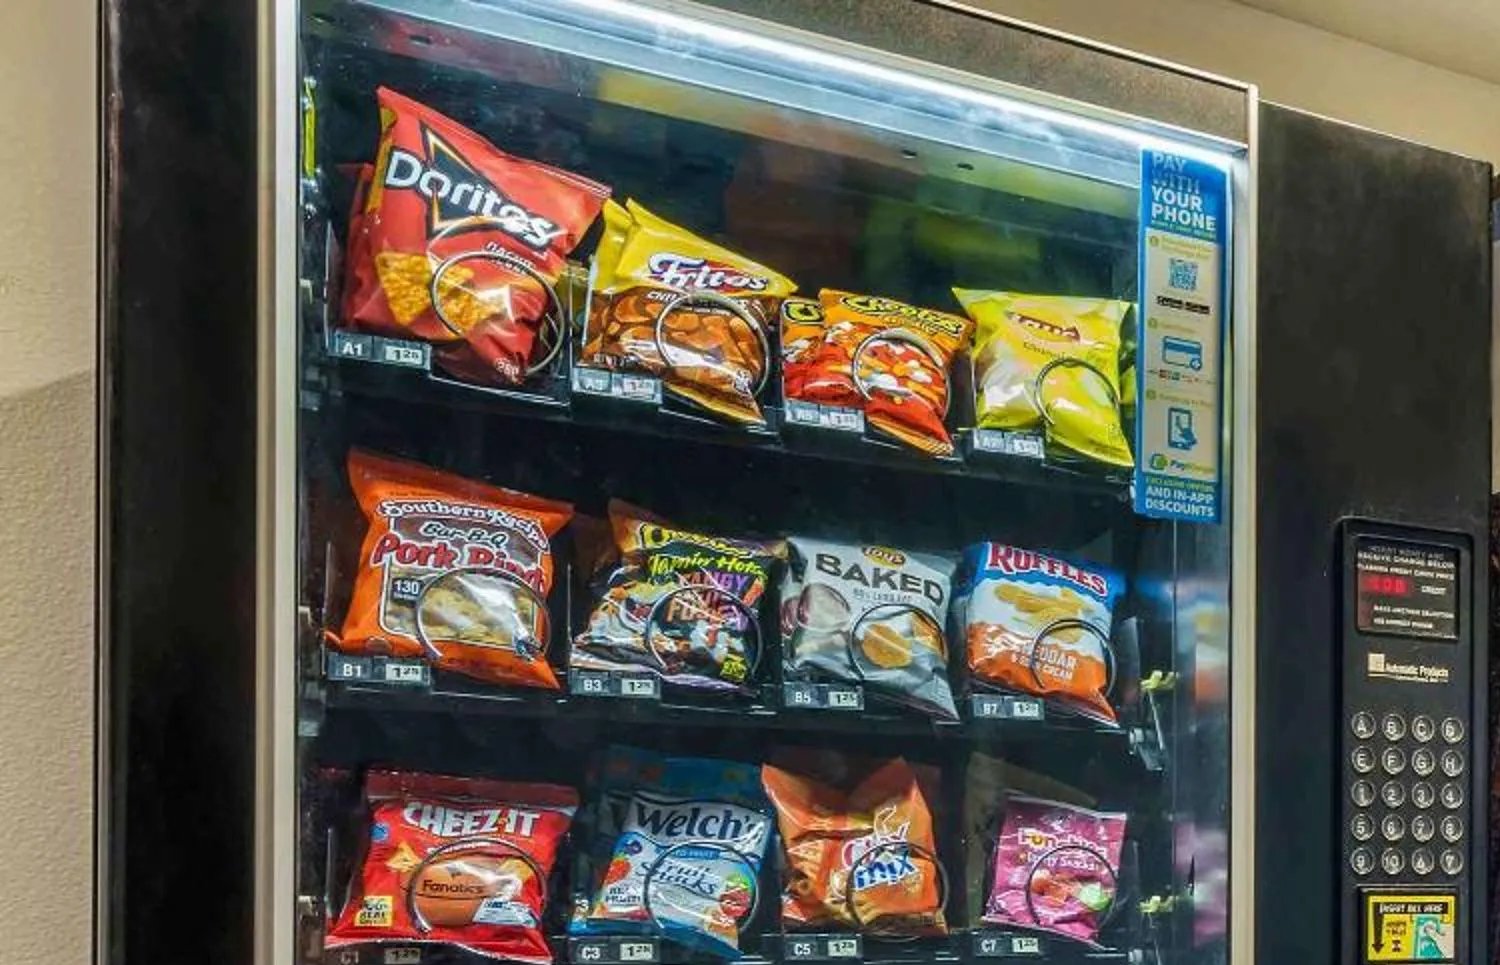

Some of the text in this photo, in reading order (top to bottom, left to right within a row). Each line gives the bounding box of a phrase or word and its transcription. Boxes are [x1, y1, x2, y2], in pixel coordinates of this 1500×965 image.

[385, 150, 560, 247] Doritos
[1152, 185, 1203, 212] YOUR
[1152, 202, 1217, 231] PHONE
[649, 253, 768, 290] Fritos
[342, 342, 362, 356] A1
[1145, 485, 1172, 499] AND
[378, 500, 486, 519] Southern
[1144, 498, 1216, 518] DISCOUNTS
[370, 531, 458, 567] Pork
[985, 541, 1108, 597] RUFFLES
[394, 580, 420, 594] 130
[816, 553, 945, 607] BAKED
[343, 664, 361, 677] B1
[584, 678, 602, 691] B3
[795, 692, 811, 704] B5
[403, 801, 541, 838] CHEEZ-IT
[421, 878, 486, 895] Fanatics
[581, 946, 600, 960] C3
[794, 943, 811, 956] C5
